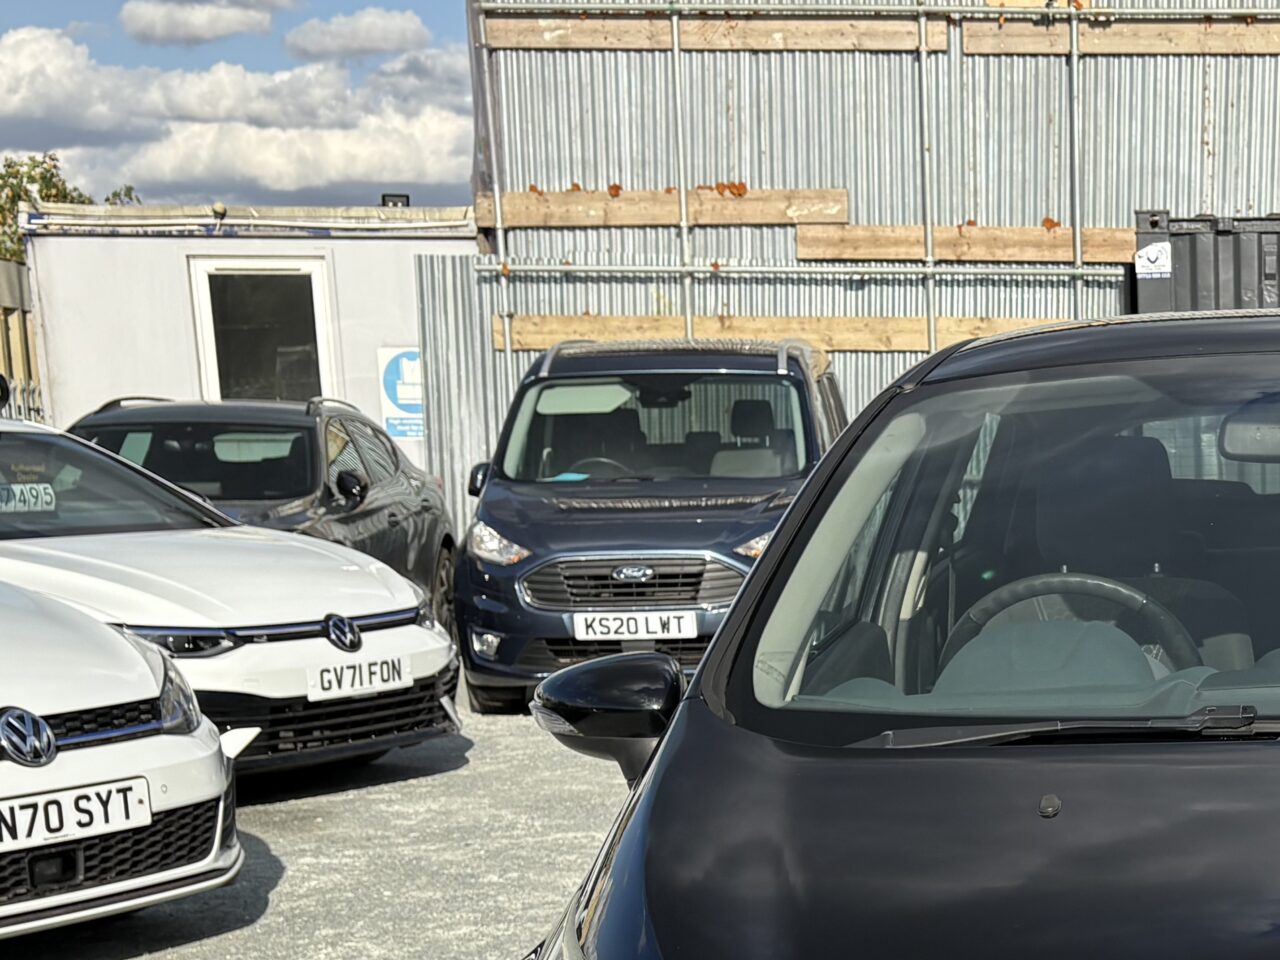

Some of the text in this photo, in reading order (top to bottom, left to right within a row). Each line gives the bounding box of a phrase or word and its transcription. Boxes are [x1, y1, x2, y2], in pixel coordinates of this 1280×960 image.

[584, 615, 685, 636] KS20 LWT
[368, 658, 402, 685] FON
[74, 786, 133, 828] SYT
